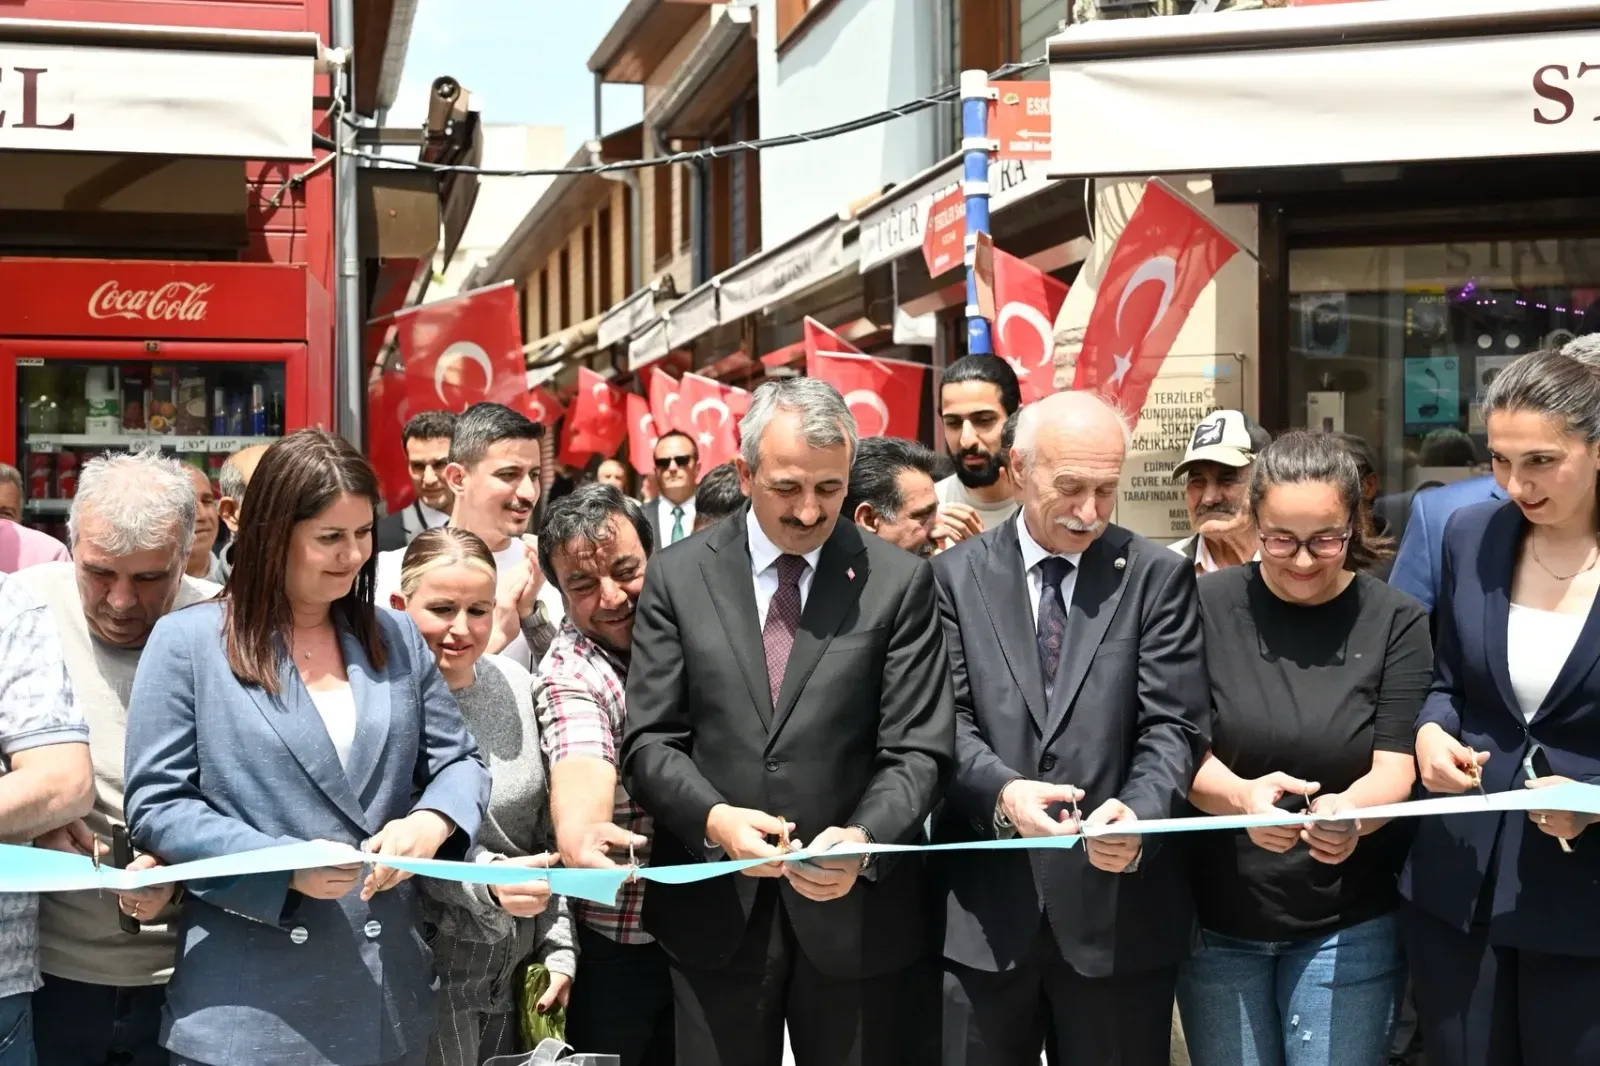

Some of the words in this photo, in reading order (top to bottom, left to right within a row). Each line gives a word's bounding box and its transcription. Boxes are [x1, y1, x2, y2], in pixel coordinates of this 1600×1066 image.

[0, 67, 74, 131] L
[88, 280, 215, 320] Coca-Cola
[1154, 389, 1203, 405] TERZİLER
[1124, 491, 1178, 501] TARAFINDAN
